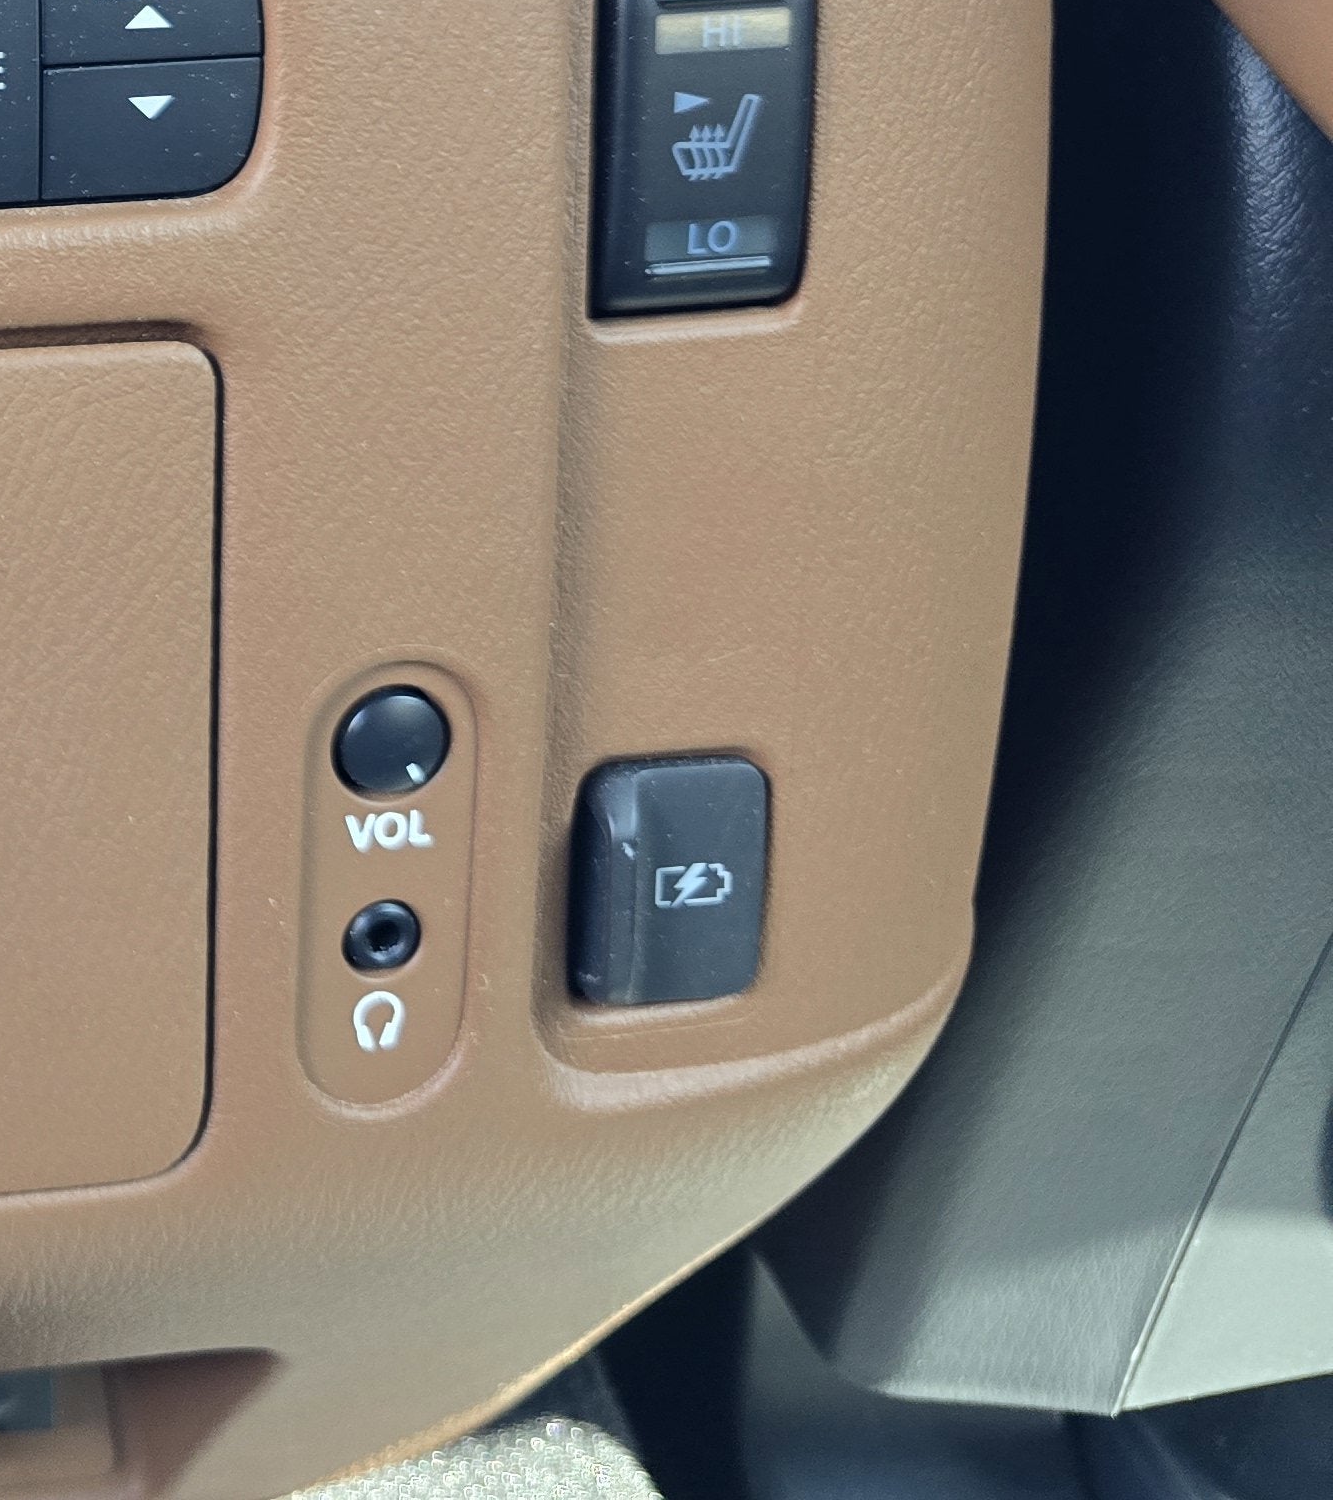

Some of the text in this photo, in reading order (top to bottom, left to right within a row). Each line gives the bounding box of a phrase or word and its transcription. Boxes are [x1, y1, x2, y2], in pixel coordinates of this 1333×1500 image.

[701, 15, 744, 49] HI
[686, 220, 738, 255] LO
[345, 809, 435, 853] VOL
